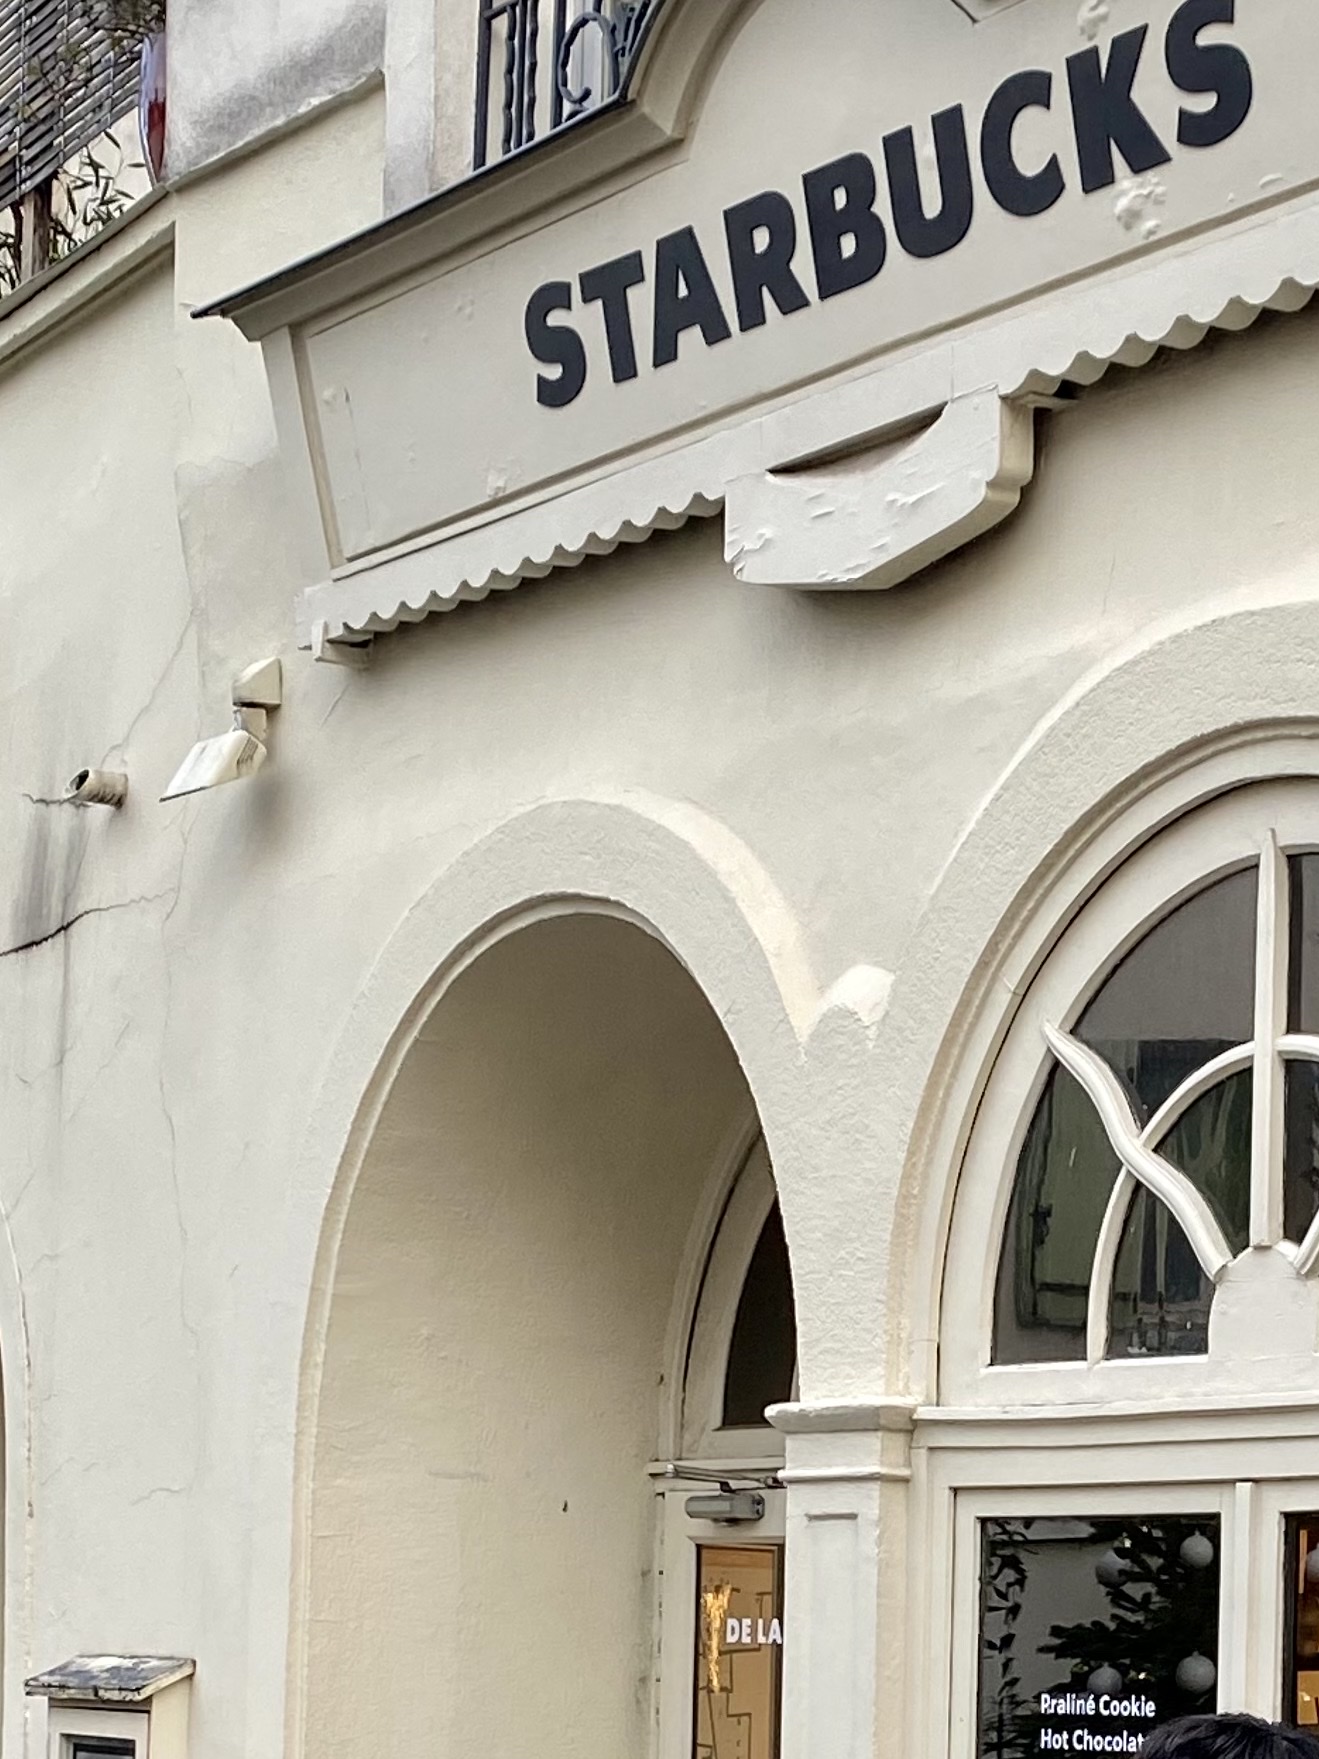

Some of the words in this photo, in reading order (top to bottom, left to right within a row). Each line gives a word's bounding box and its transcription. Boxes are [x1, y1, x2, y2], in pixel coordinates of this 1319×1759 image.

[523, 0, 1254, 408] STARBUCKS
[726, 1617, 752, 1644] DE
[757, 1617, 783, 1645] LA
[1040, 1692, 1096, 1716] Praliné
[1099, 1693, 1157, 1718] Cookie
[1040, 1728, 1069, 1750] Hot
[1072, 1728, 1146, 1752] Chocolat
